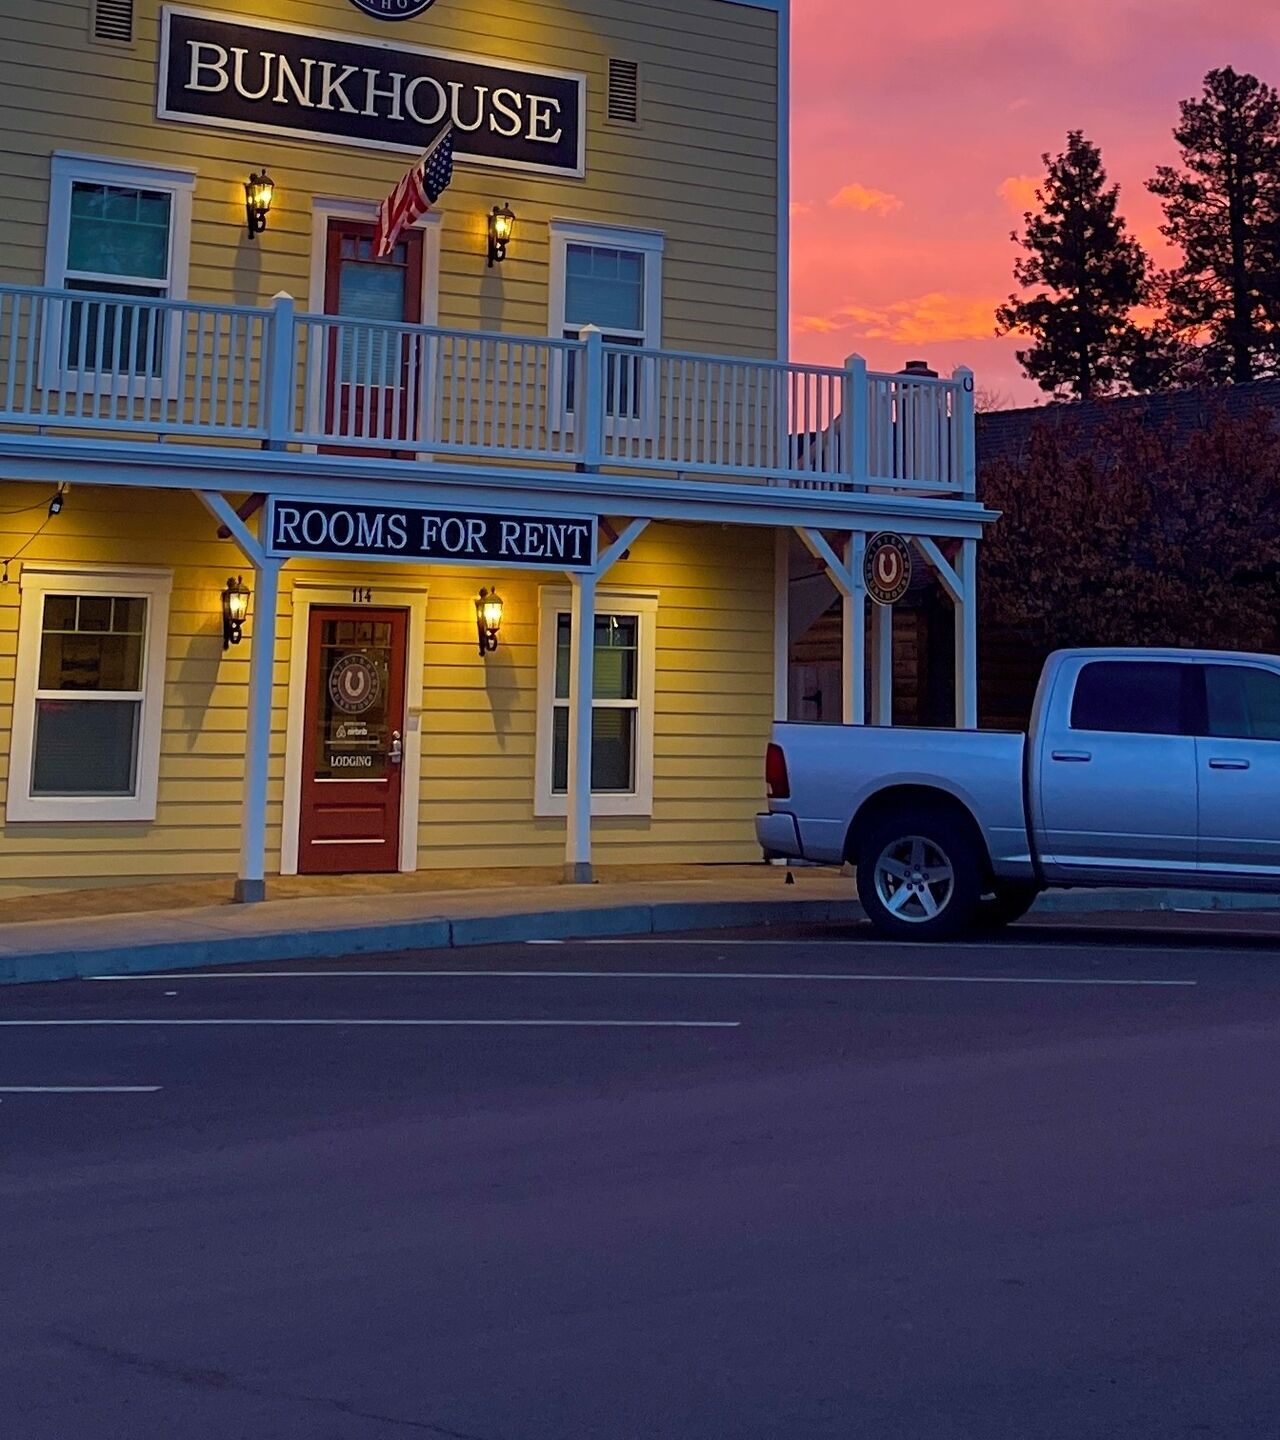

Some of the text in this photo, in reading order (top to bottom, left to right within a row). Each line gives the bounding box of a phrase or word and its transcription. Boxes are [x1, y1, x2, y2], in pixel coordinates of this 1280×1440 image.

[183, 39, 563, 145] BUNKHOUSE
[276, 507, 589, 559] ROOMS FOR RENT
[352, 587, 372, 603] 114
[330, 755, 372, 767] LODGING
